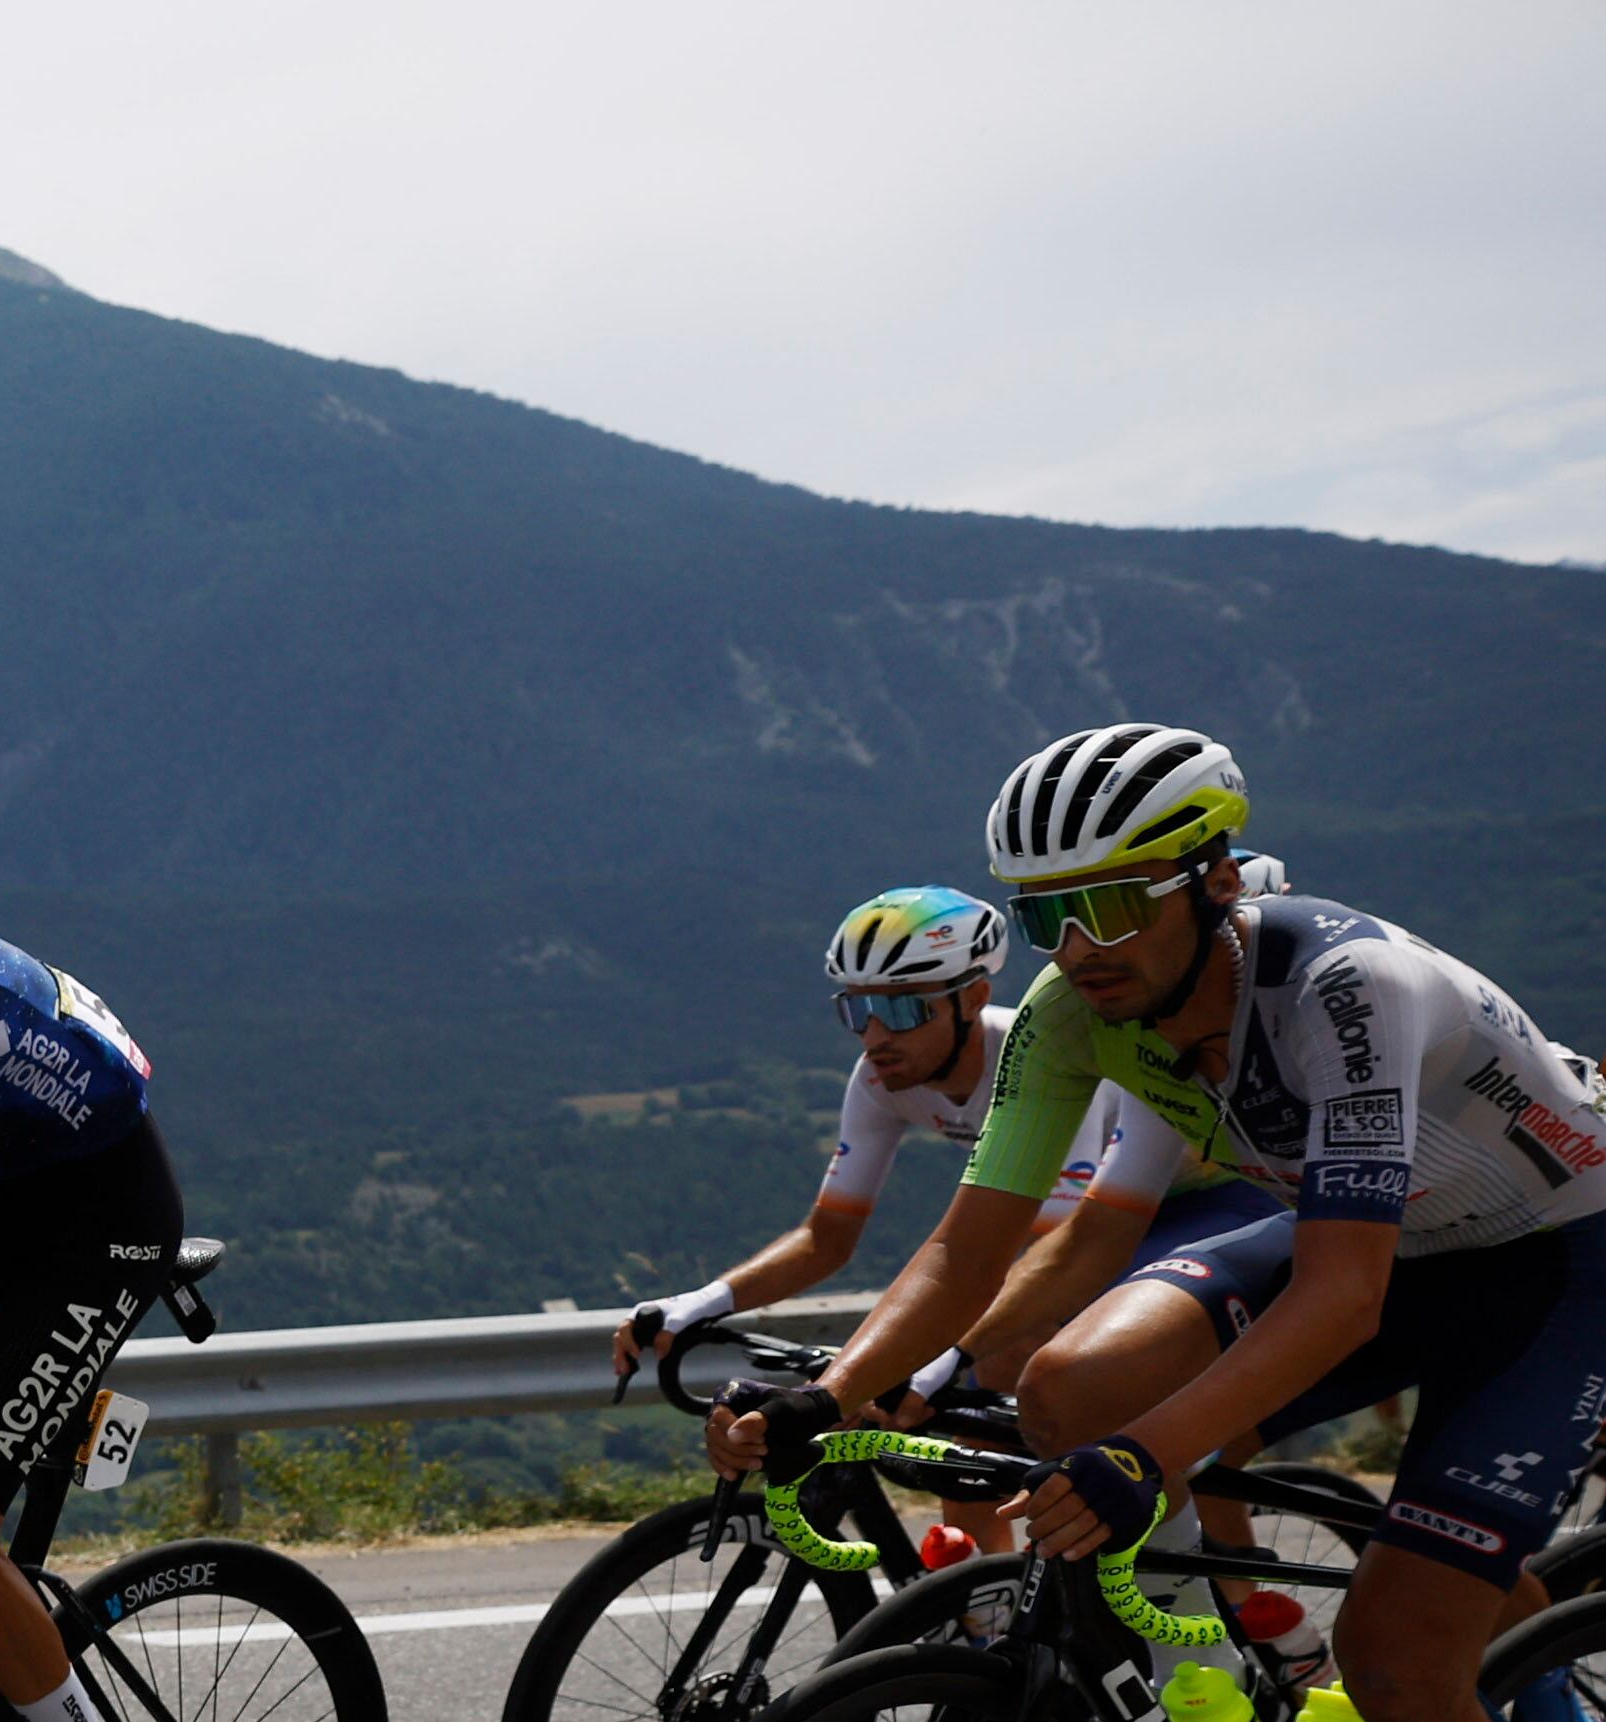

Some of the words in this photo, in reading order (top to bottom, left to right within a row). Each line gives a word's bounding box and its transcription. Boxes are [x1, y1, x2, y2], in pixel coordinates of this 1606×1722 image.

[1102, 771, 1123, 795] uvex
[1312, 954, 1382, 1085] Wallonie
[17, 1028, 71, 1070] AG2R
[63, 1056, 92, 1095] LA
[1332, 1099, 1396, 1117] PIERRE
[1355, 1114, 1398, 1133] SOL
[1314, 1162, 1407, 1197] Full
[50, 1301, 105, 1356] LA
[19, 1287, 139, 1476] MONDIALE
[98, 1419, 138, 1465] 52
[1444, 1466, 1544, 1508] CUBE
[1397, 1505, 1493, 1546] WANTY
[123, 1569, 178, 1608] SWISS
[179, 1562, 218, 1588] SIDE
